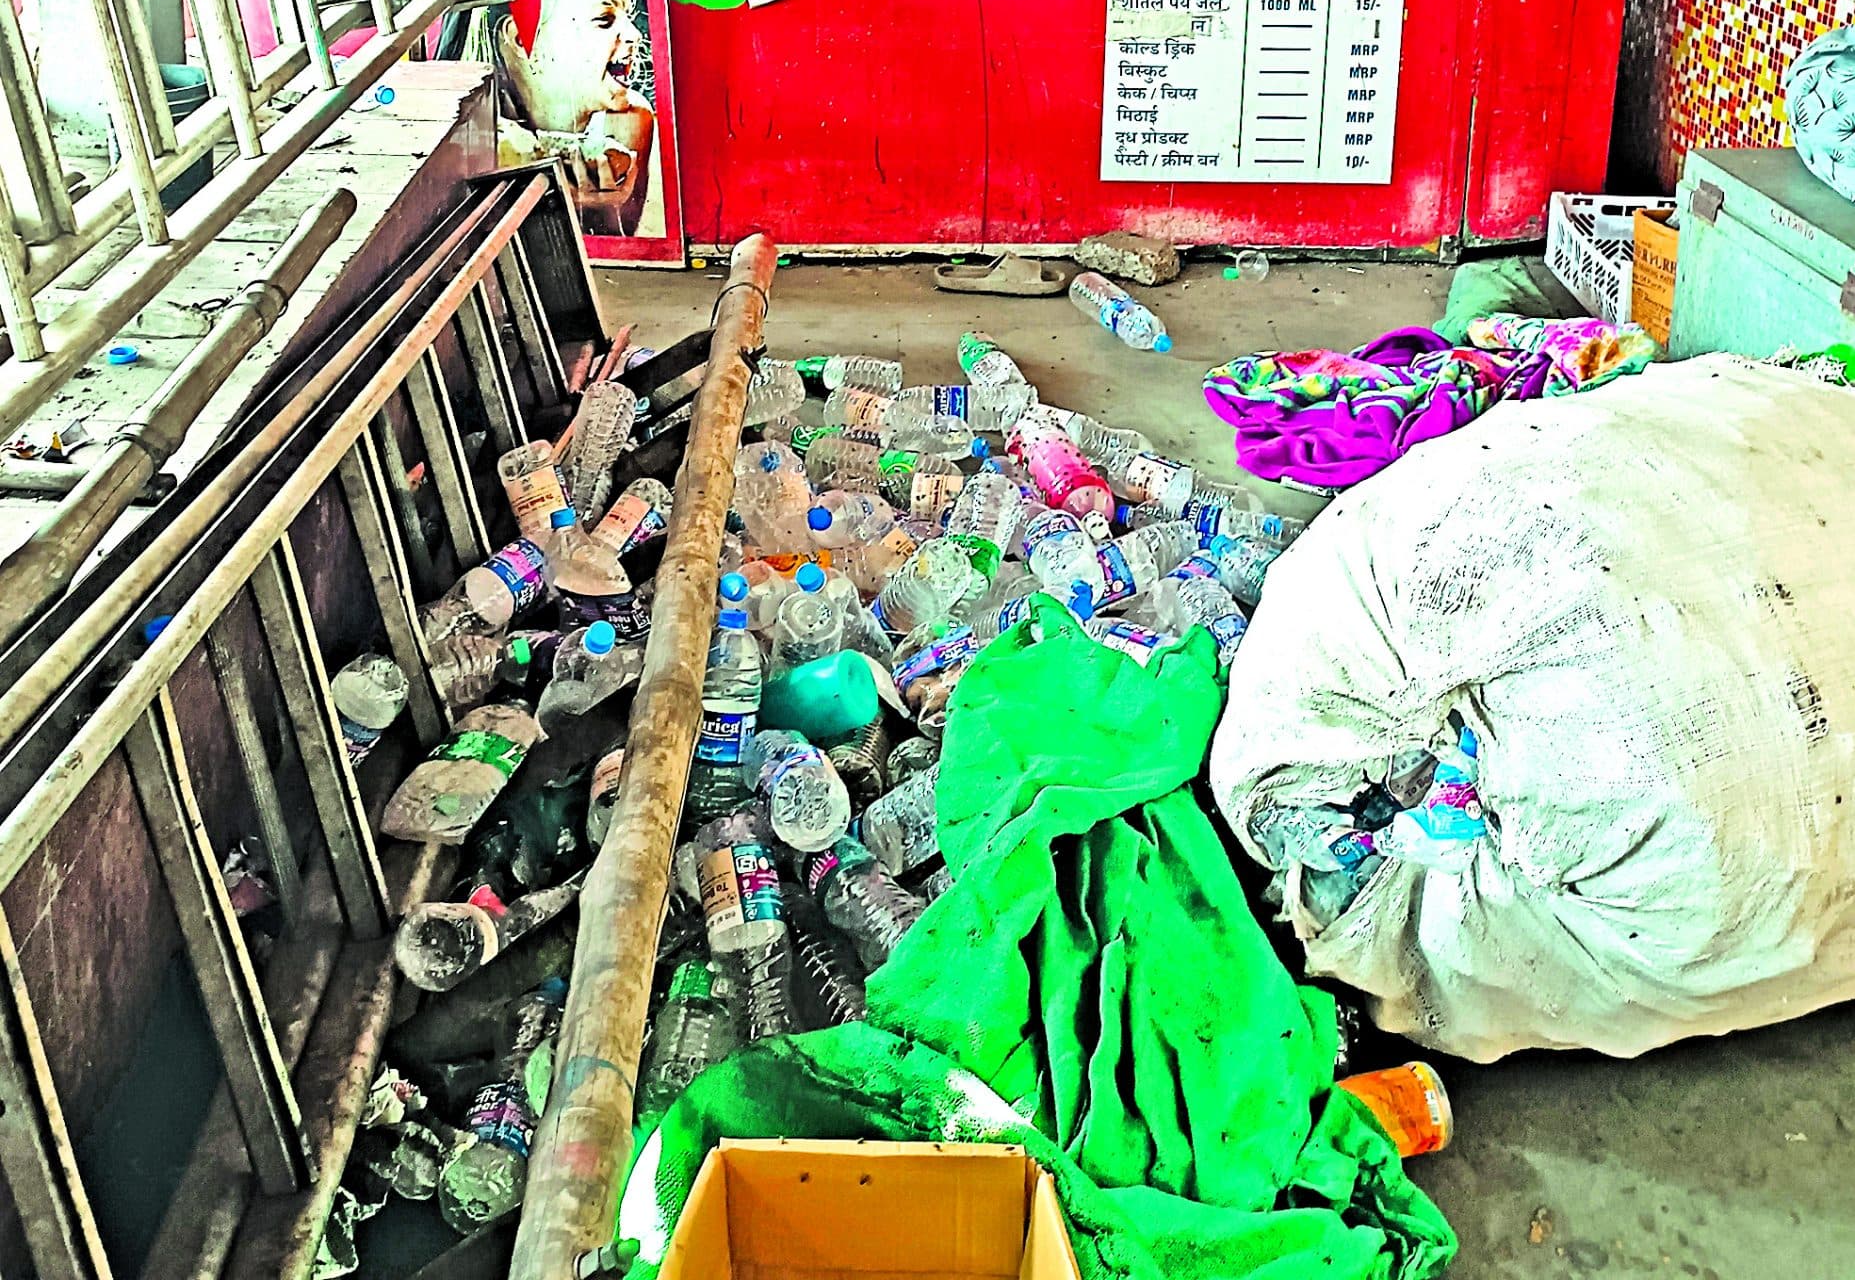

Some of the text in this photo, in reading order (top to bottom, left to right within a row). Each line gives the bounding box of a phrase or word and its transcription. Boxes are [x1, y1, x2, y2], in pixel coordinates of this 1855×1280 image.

[1261, 0, 1316, 11] 1000 ML
[1356, 0, 1381, 11] 15/-
[1351, 44, 1379, 56] MRP
[1349, 67, 1378, 78] MRP
[1117, 83, 1147, 100] केक
[1160, 83, 1198, 100] चिप्स
[1347, 89, 1376, 101] MRP
[1116, 104, 1159, 125] मिठाई
[1346, 112, 1374, 123] MRP
[1344, 134, 1373, 145] MRP
[1161, 150, 1194, 167] क्रीम
